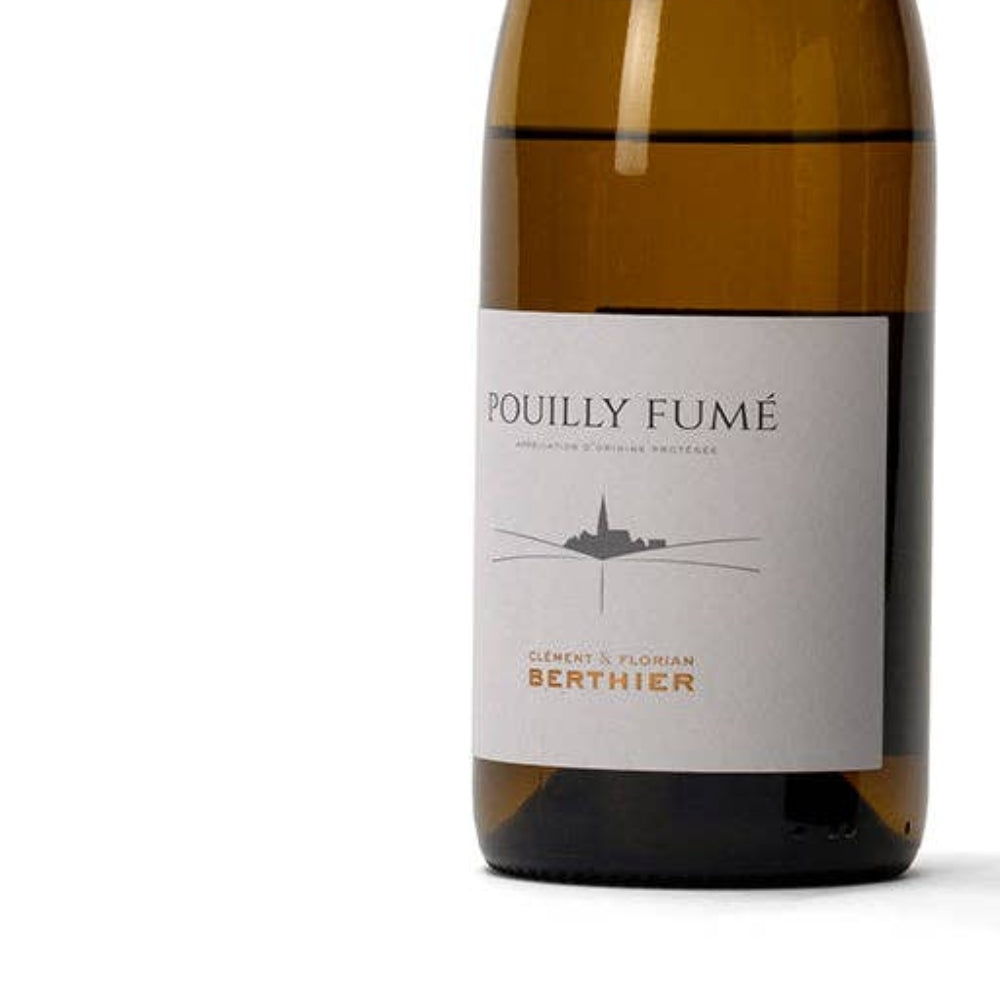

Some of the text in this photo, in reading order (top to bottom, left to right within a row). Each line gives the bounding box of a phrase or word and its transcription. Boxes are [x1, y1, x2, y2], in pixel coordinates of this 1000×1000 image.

[488, 391, 778, 431] POUILLY FUMÉ
[528, 667, 696, 692] BERTHIER
